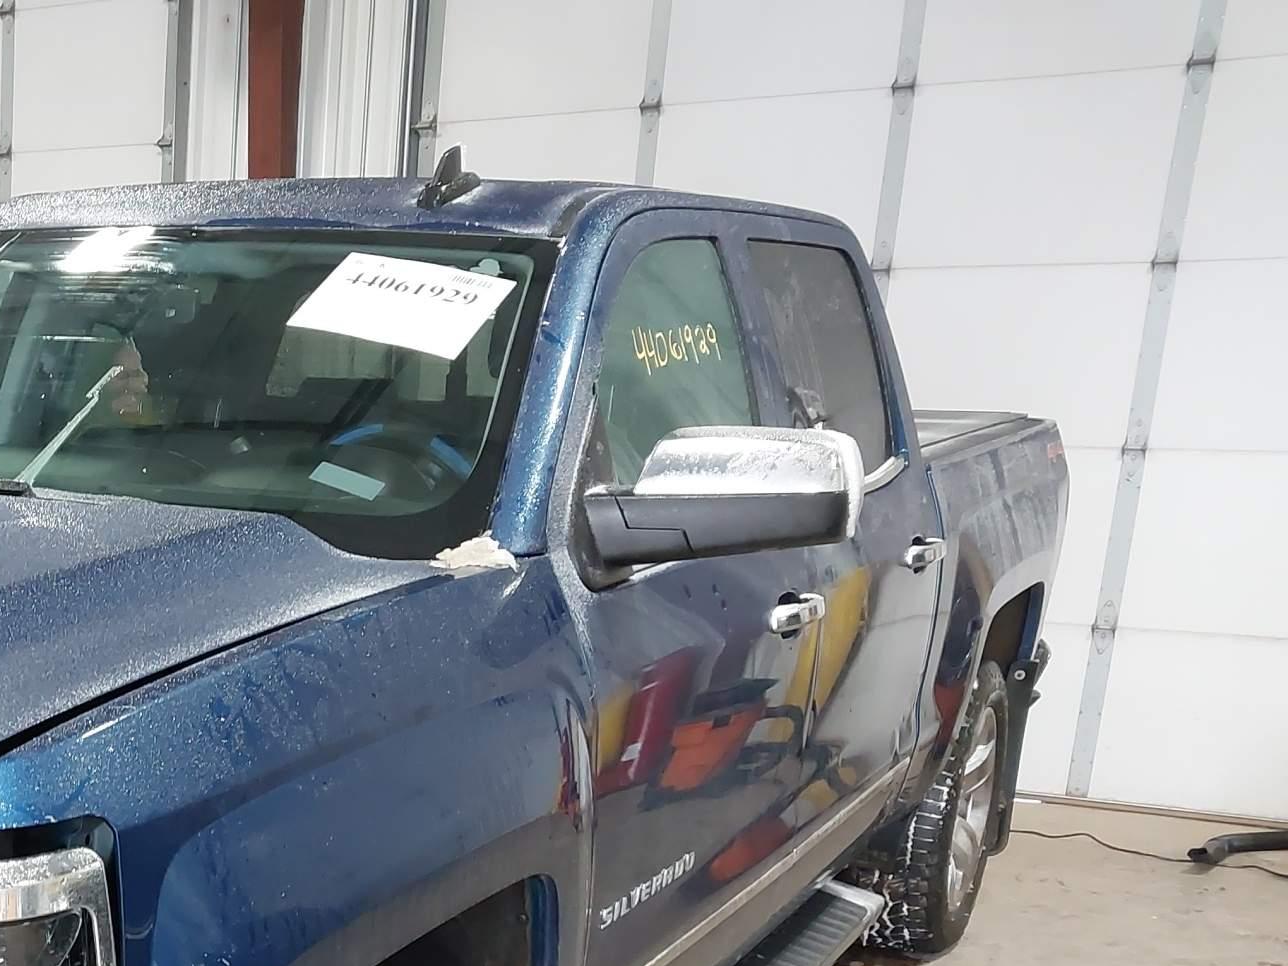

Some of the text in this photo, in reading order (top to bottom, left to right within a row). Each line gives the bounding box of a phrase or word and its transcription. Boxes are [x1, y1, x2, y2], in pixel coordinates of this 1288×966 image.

[346, 272, 479, 305] 44061929
[631, 323, 722, 376] 44061929
[599, 851, 695, 930] SILVERADO
